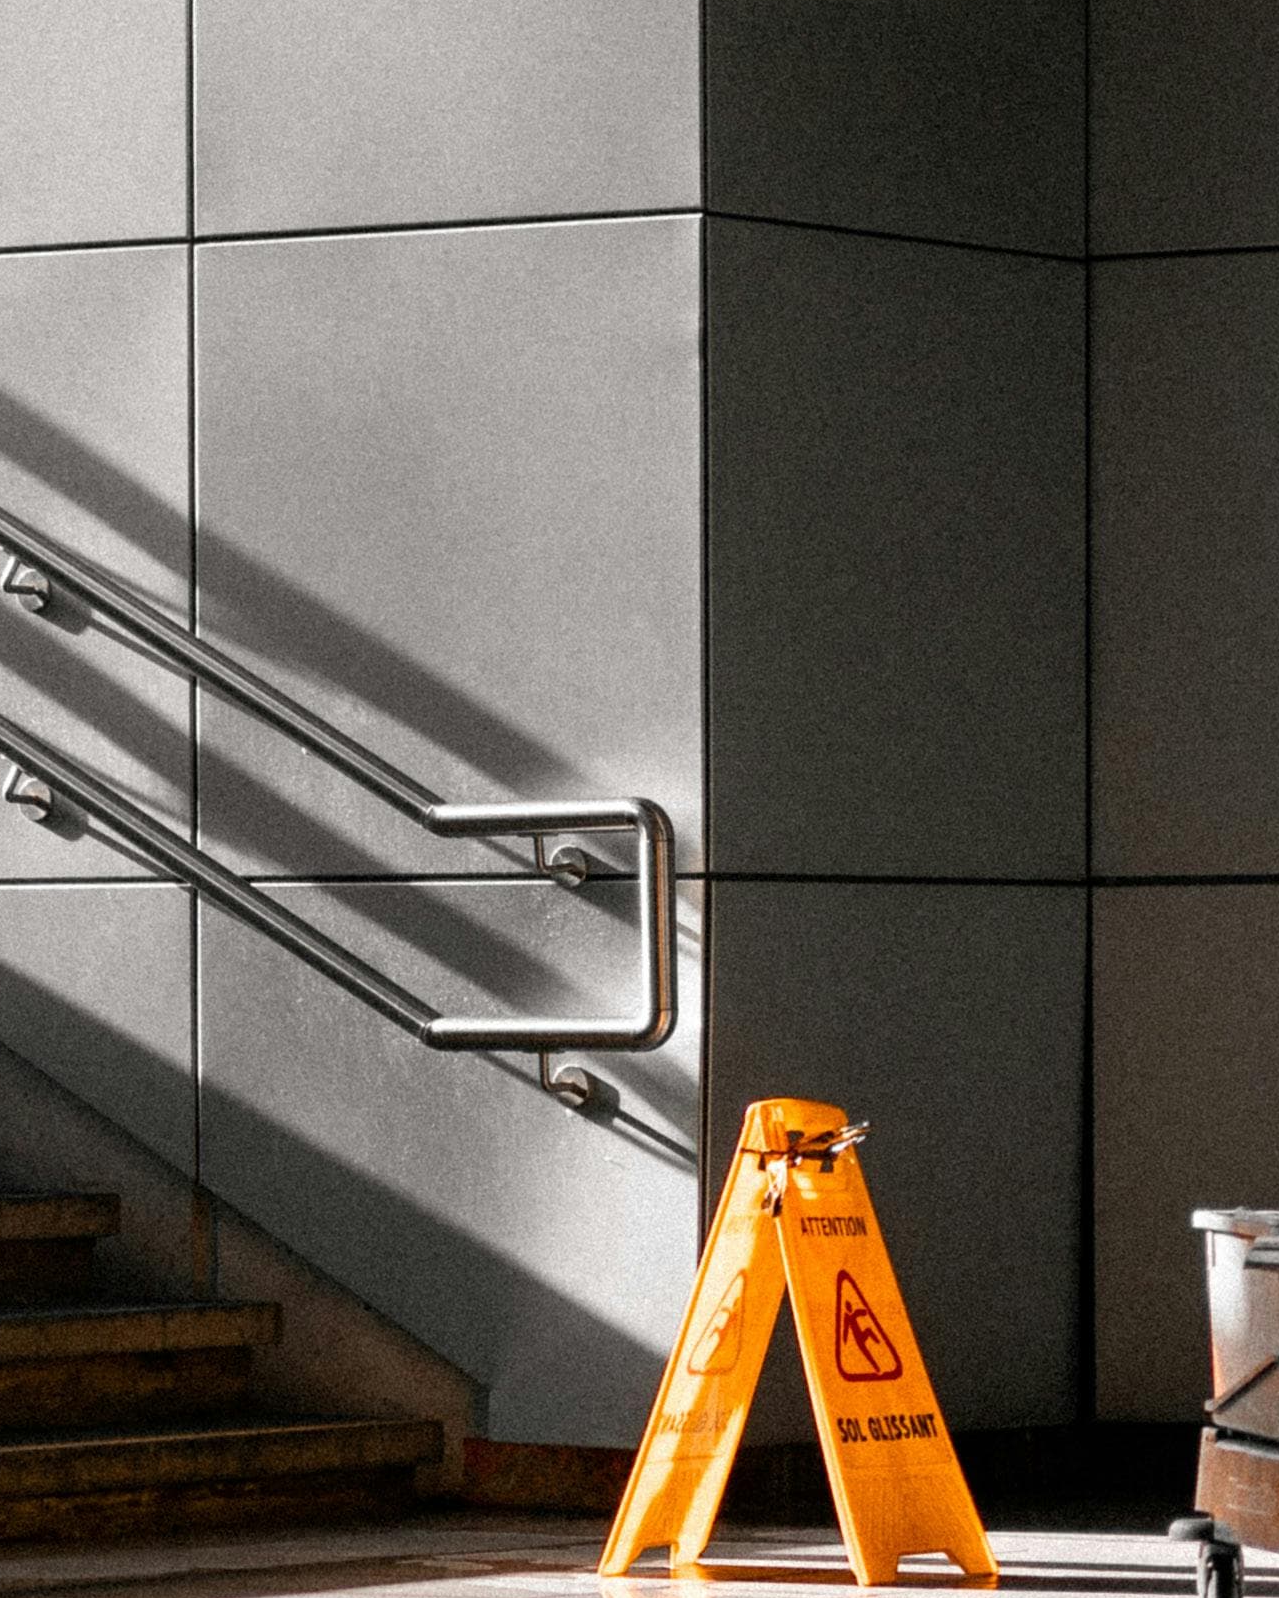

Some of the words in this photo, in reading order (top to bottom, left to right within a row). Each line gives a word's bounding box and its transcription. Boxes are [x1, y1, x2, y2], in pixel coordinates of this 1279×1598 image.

[801, 1216, 867, 1237] ATTENTION
[837, 1417, 867, 1443] SOL
[868, 1413, 938, 1441] GLISSANT
